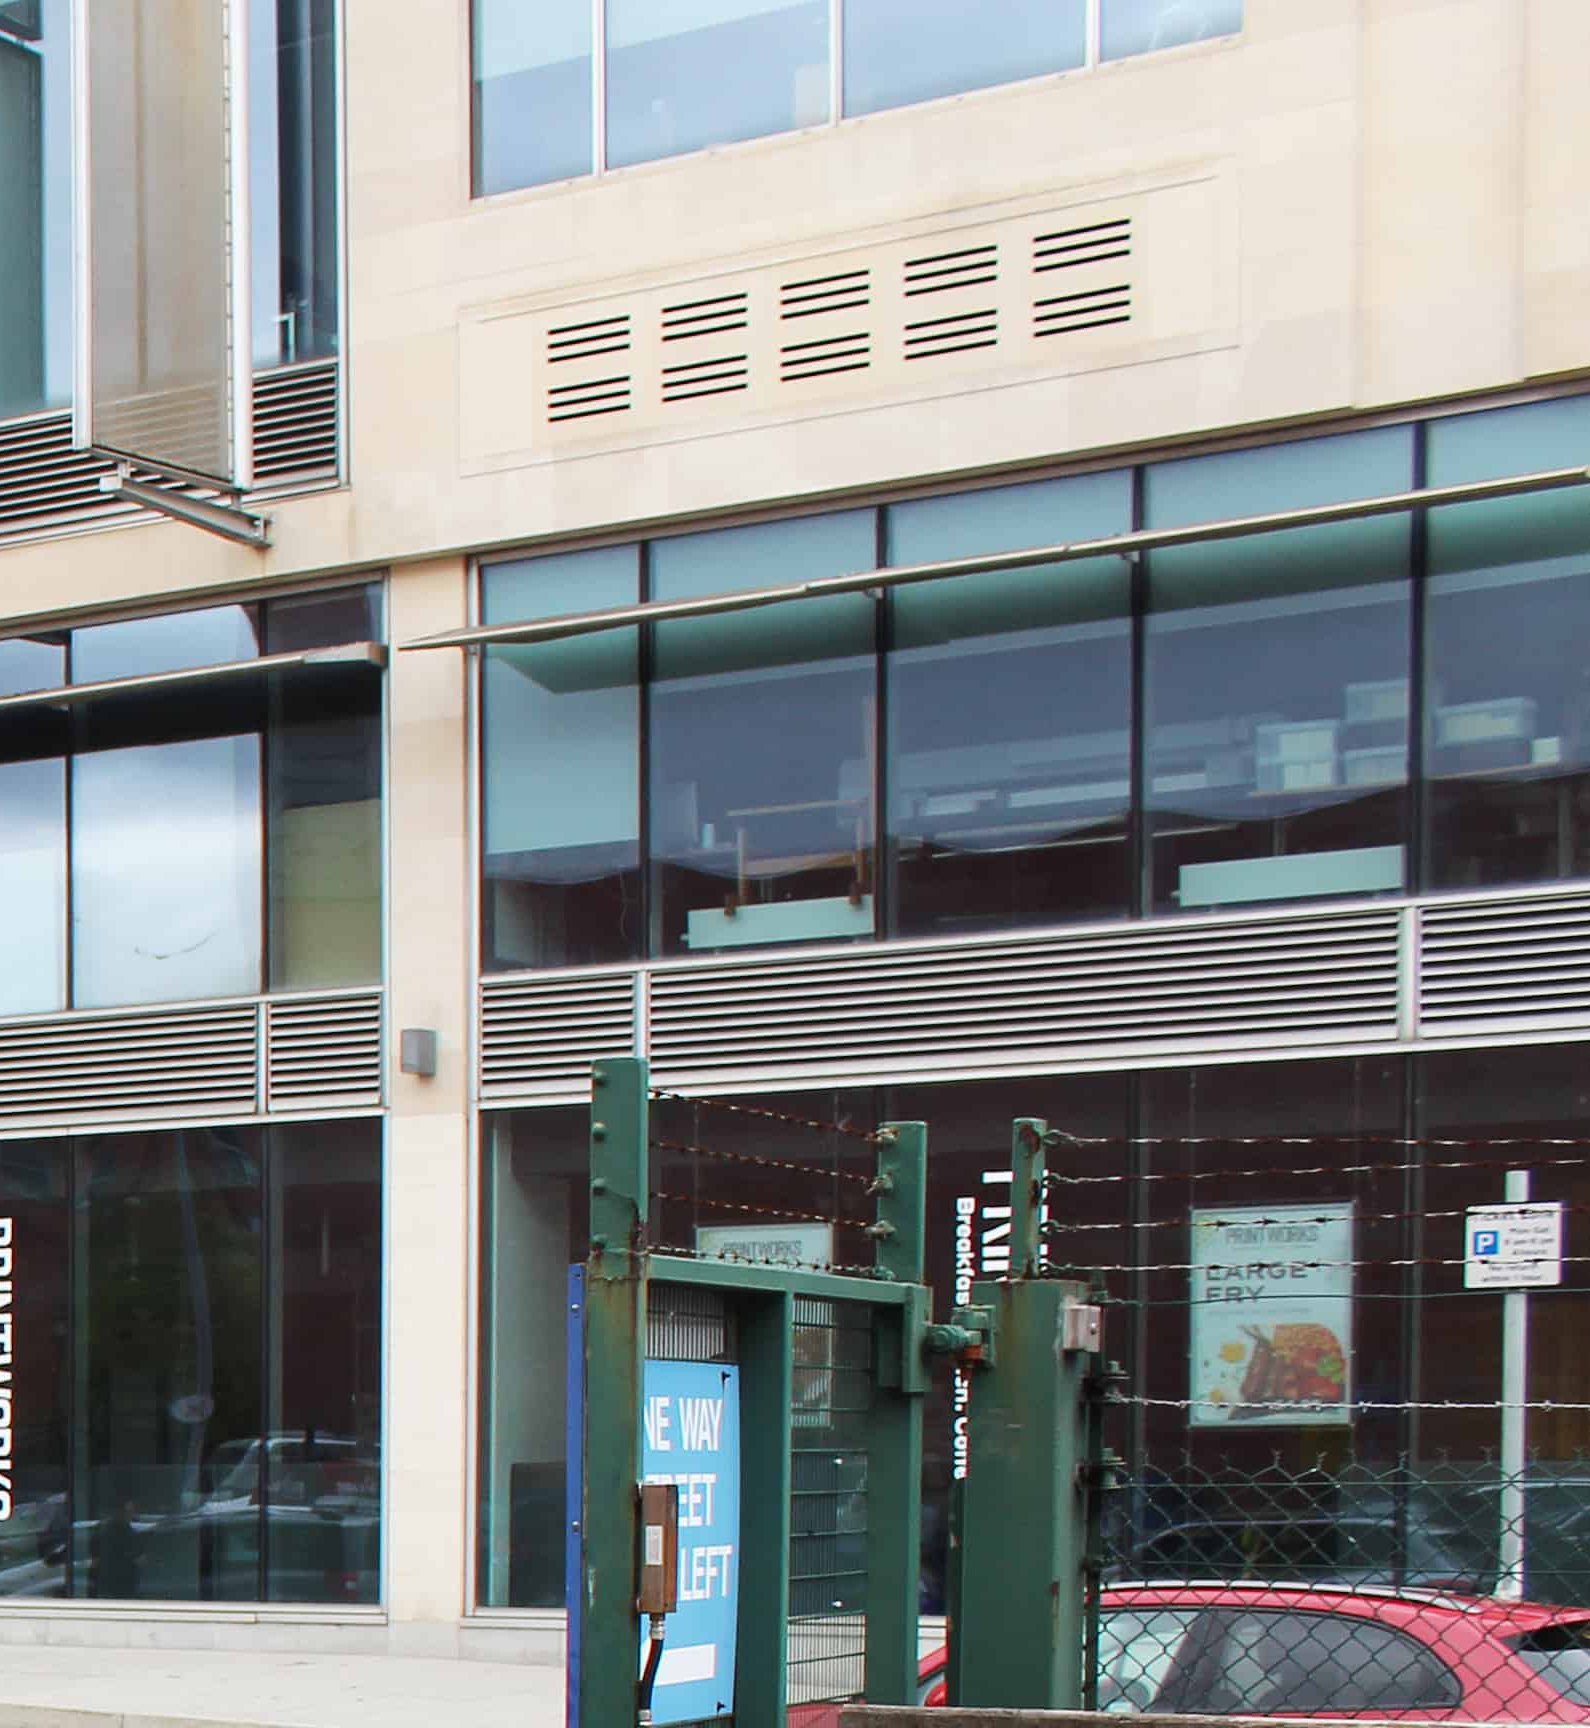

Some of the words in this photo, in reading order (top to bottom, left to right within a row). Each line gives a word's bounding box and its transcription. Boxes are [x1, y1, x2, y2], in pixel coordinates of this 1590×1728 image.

[1478, 1233, 1495, 1254] P
[1205, 1261, 1309, 1281] LARGE
[643, 1396, 672, 1451] NE
[678, 1396, 724, 1452] WAY
[680, 1544, 733, 1602] LEFT
